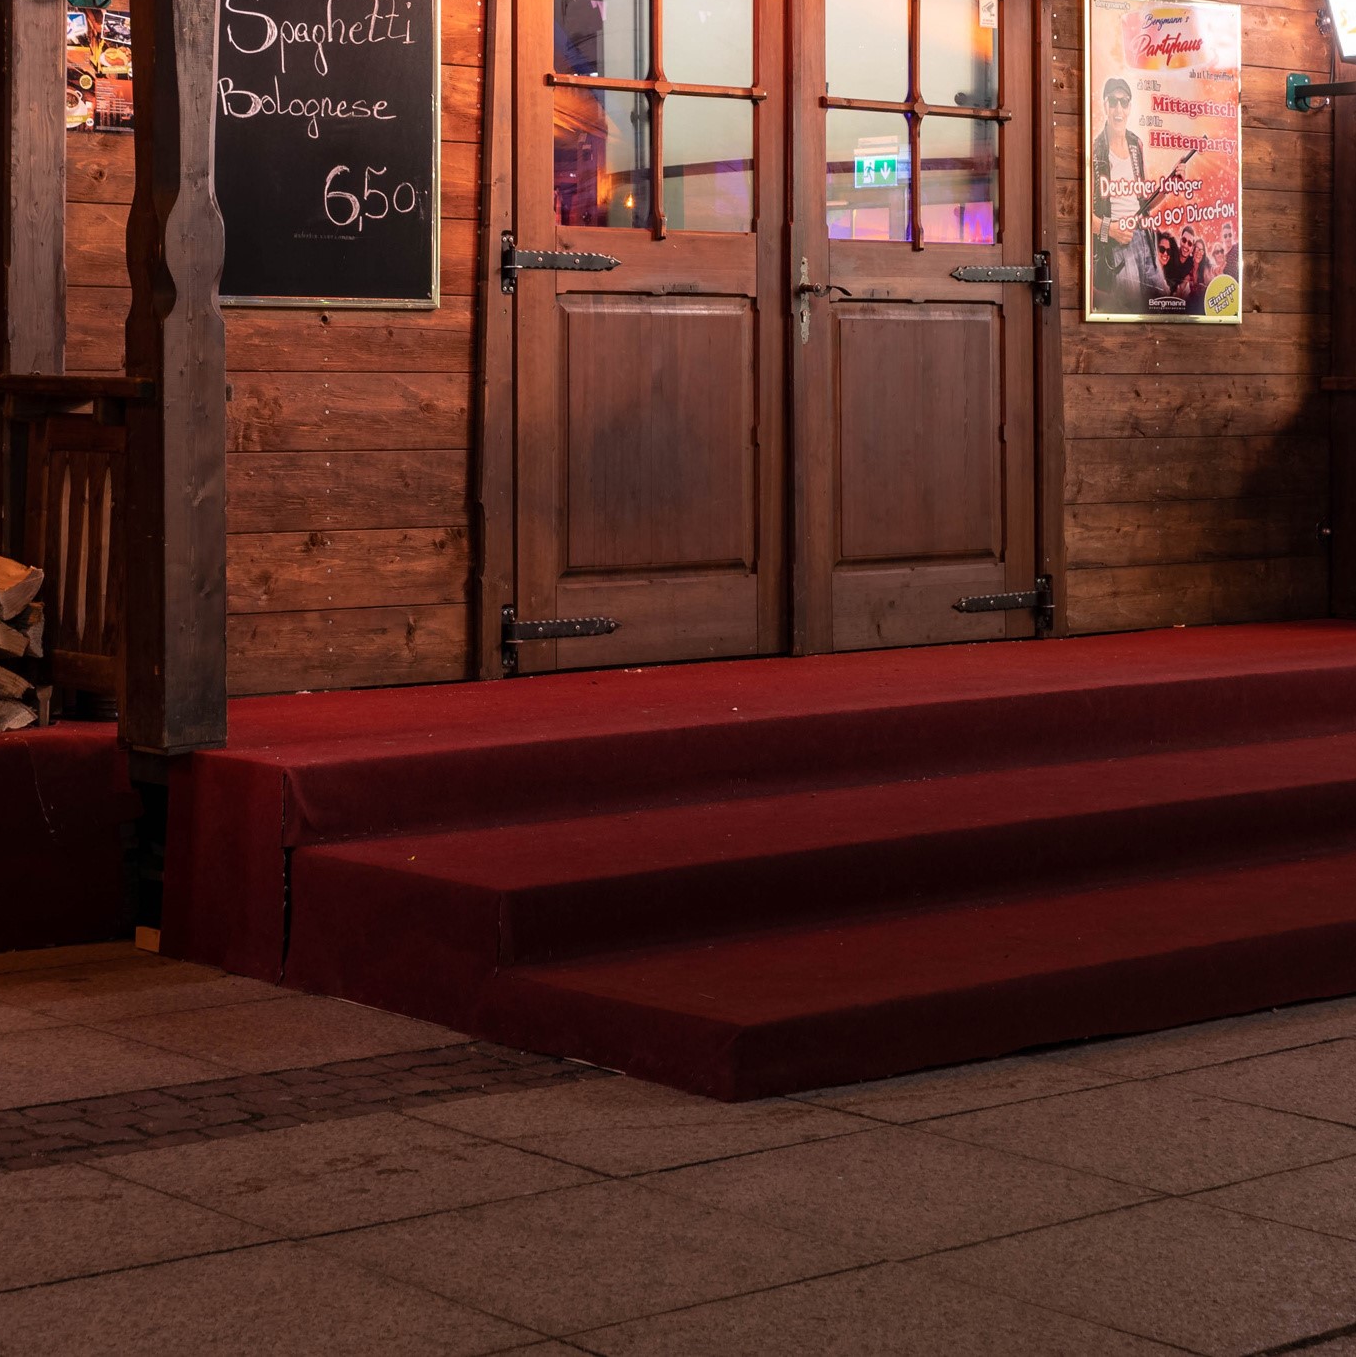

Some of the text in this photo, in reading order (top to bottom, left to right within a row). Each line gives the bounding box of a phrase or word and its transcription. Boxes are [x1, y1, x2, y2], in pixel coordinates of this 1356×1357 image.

[1134, 33, 1203, 66] Partyhaus
[218, 75, 396, 139] Bolognese
[1152, 96, 1236, 117] Mittagstisch
[1150, 132, 1236, 154] Hüttenparty
[324, 165, 416, 232] 6,50
[1100, 177, 1203, 199] Deutscher Schlager
[1141, 212, 1162, 230] und
[1208, 284, 1236, 308] Eintritt
[1214, 299, 1229, 314] frei
